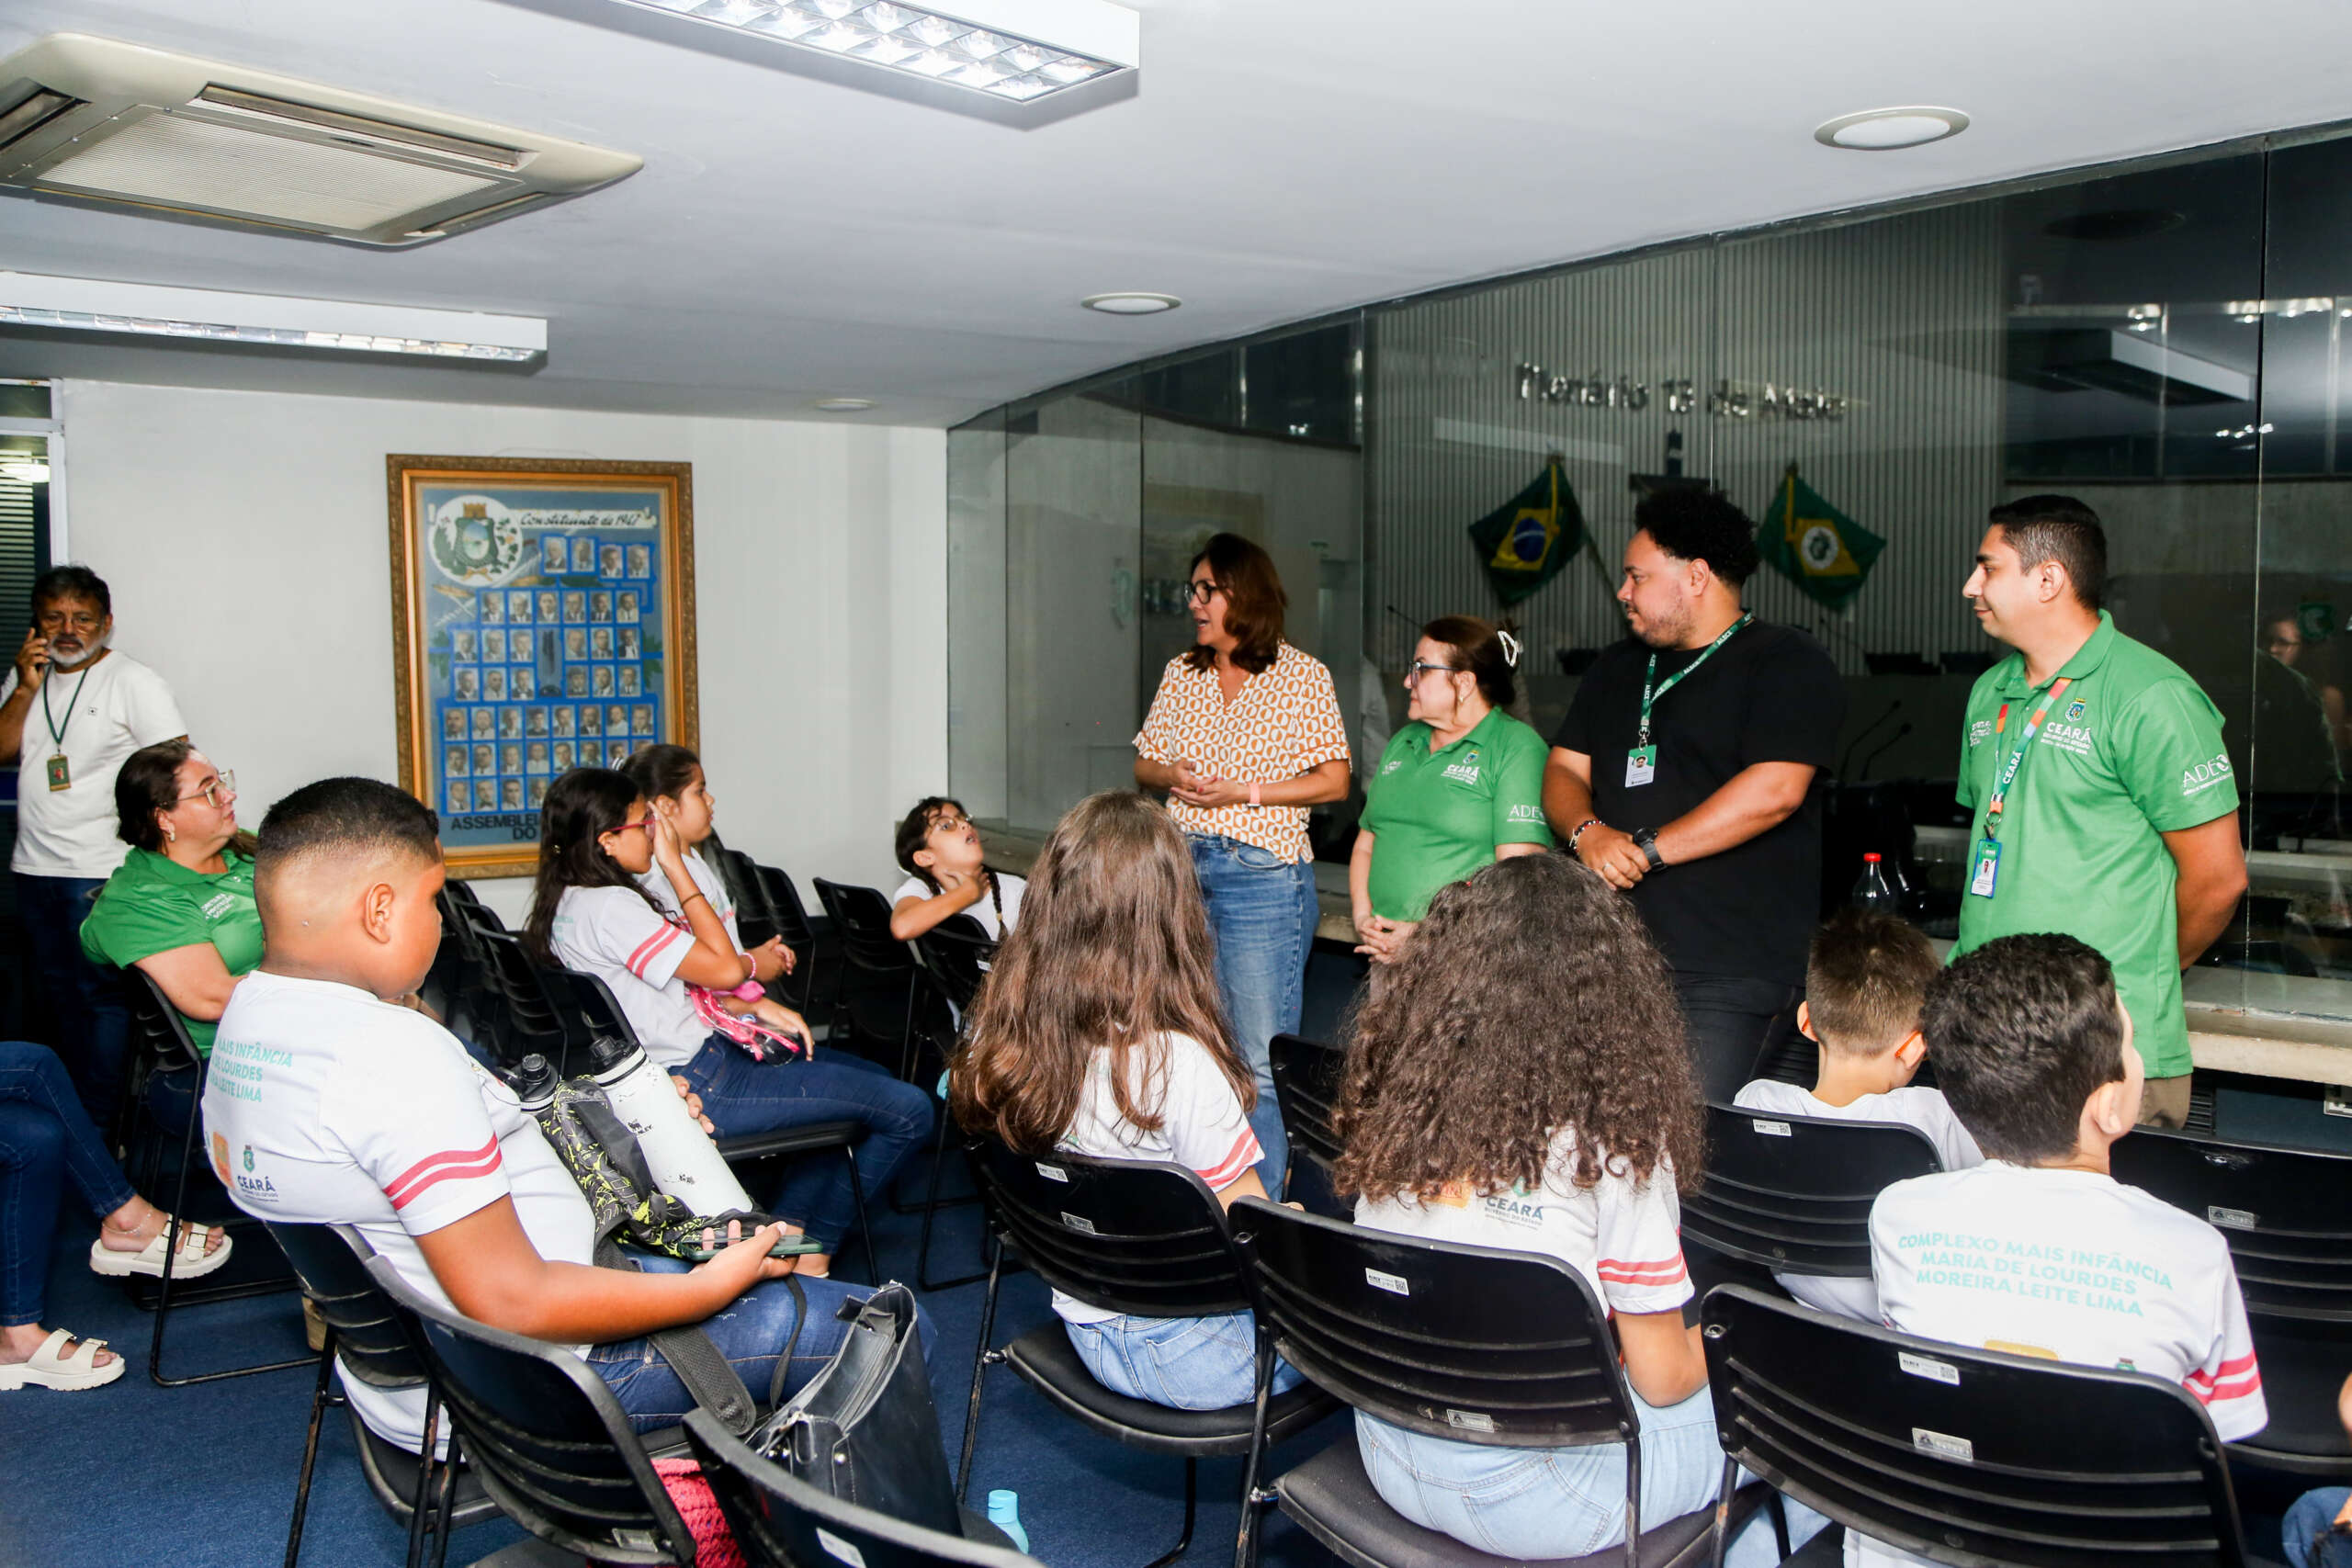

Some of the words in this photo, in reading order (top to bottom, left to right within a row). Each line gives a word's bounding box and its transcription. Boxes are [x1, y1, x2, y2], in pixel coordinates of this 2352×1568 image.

[2046, 721, 2092, 744] CEARÁ
[1446, 762, 1480, 778] CEARÁ
[2002, 750, 2023, 784] CEARÁ
[450, 813, 538, 830] ASSEMBLEI
[512, 826, 537, 840] DO
[234, 1042, 293, 1067] INFÂNCIA
[220, 1059, 263, 1082] LOURDES
[236, 1083, 263, 1102] LIMA
[237, 1175, 277, 1192] CEARÁ
[1486, 1196, 1544, 1221] CEARÁ
[1897, 1232, 1999, 1253] COMPLEXO
[2004, 1241, 2065, 1263] MAIS
[2070, 1250, 2174, 1291] INFÂNCIA
[1920, 1250, 1988, 1271] MARIA
[1994, 1258, 2024, 1275] DE
[2030, 1264, 2138, 1296] LOURDES
[1916, 1269, 2012, 1294] MOREIRA
[2018, 1281, 2079, 1306] LEITE
[2085, 1292, 2144, 1318] LIMA
